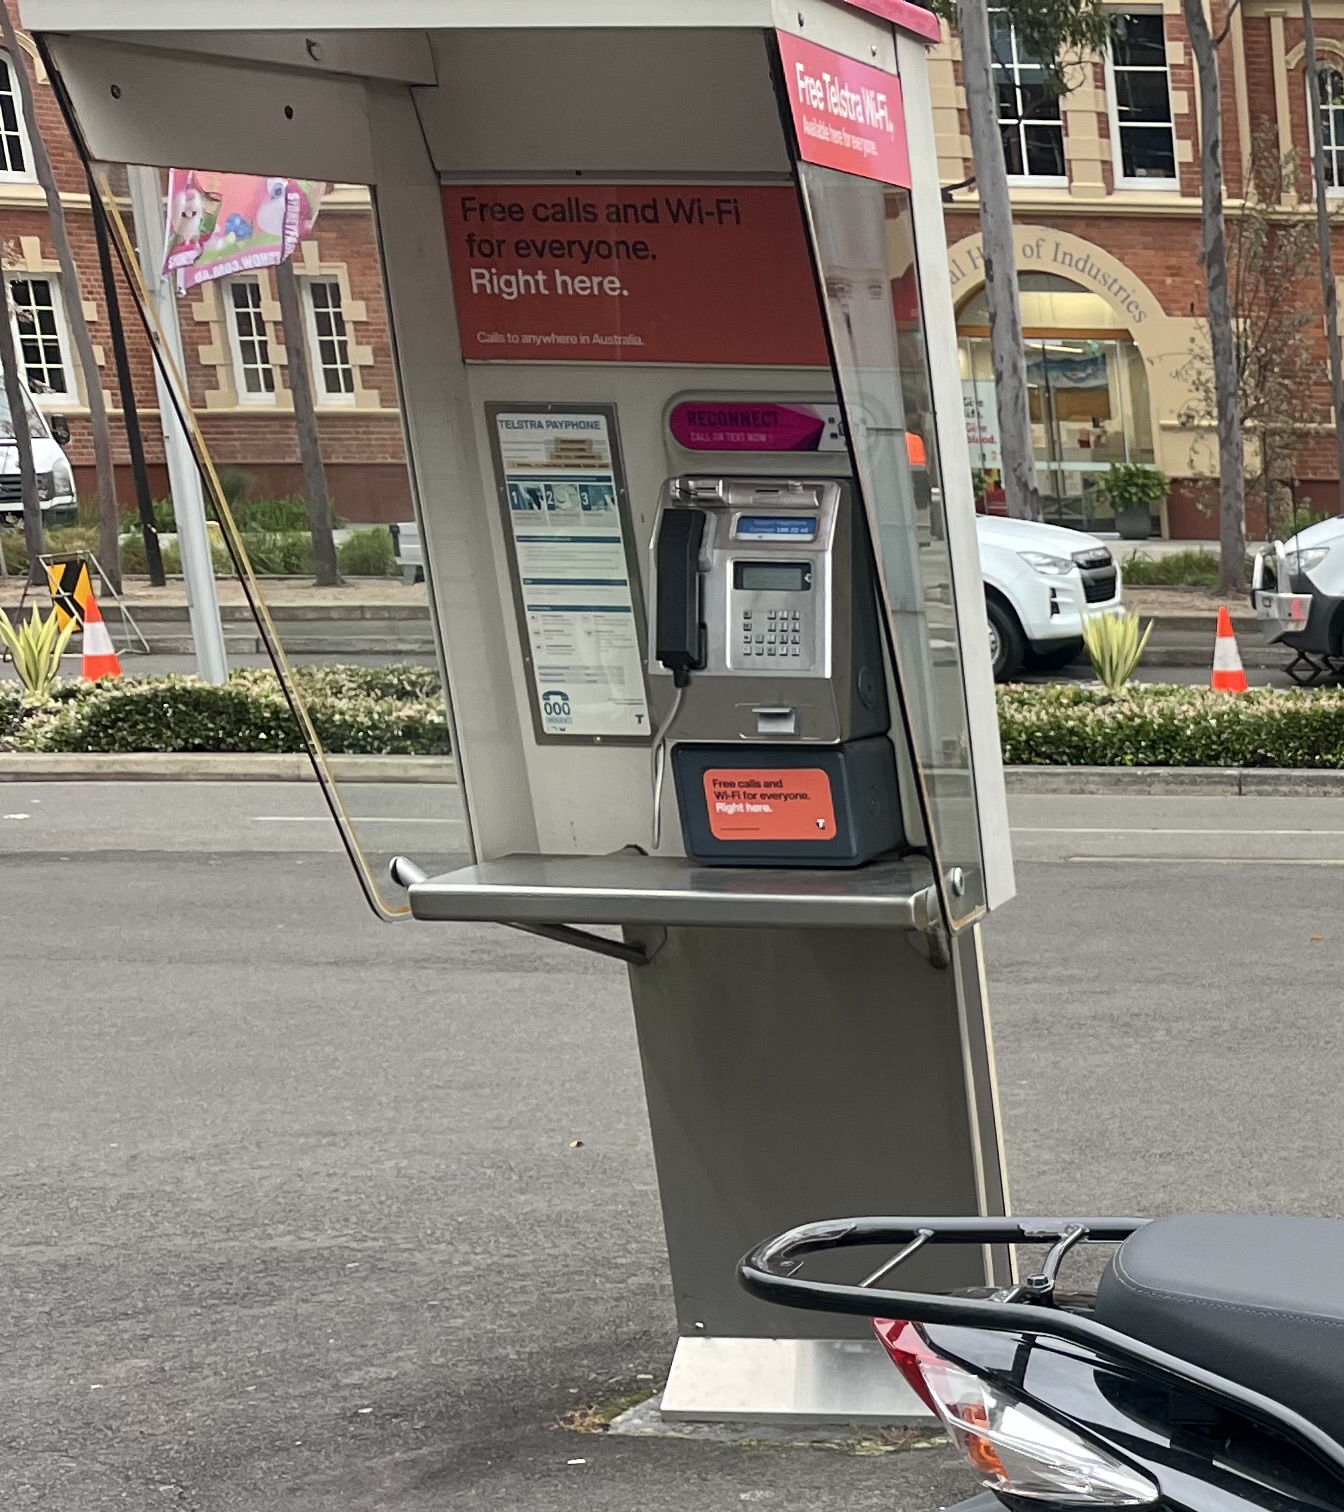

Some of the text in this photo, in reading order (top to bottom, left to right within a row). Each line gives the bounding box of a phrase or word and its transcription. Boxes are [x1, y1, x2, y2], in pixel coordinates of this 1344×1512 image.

[795, 62, 824, 110] Free
[822, 72, 864, 124] Telstra
[461, 196, 741, 225] Free calls and Wi-Fi
[465, 232, 657, 264] for everyone.
[470, 268, 629, 300] Right here.
[1021, 238, 1045, 259] of
[1051, 240, 1148, 324] Industries
[476, 331, 645, 346] Calls to anywhere in Australia.
[499, 420, 602, 431] TELSTRA PAYPHONE
[511, 491, 589, 505] 1 2 3
[544, 701, 571, 716] 000
[712, 779, 783, 789] Free calls and
[714, 791, 811, 802] Wi-Fi for everyone.
[715, 802, 773, 814] Right here.
